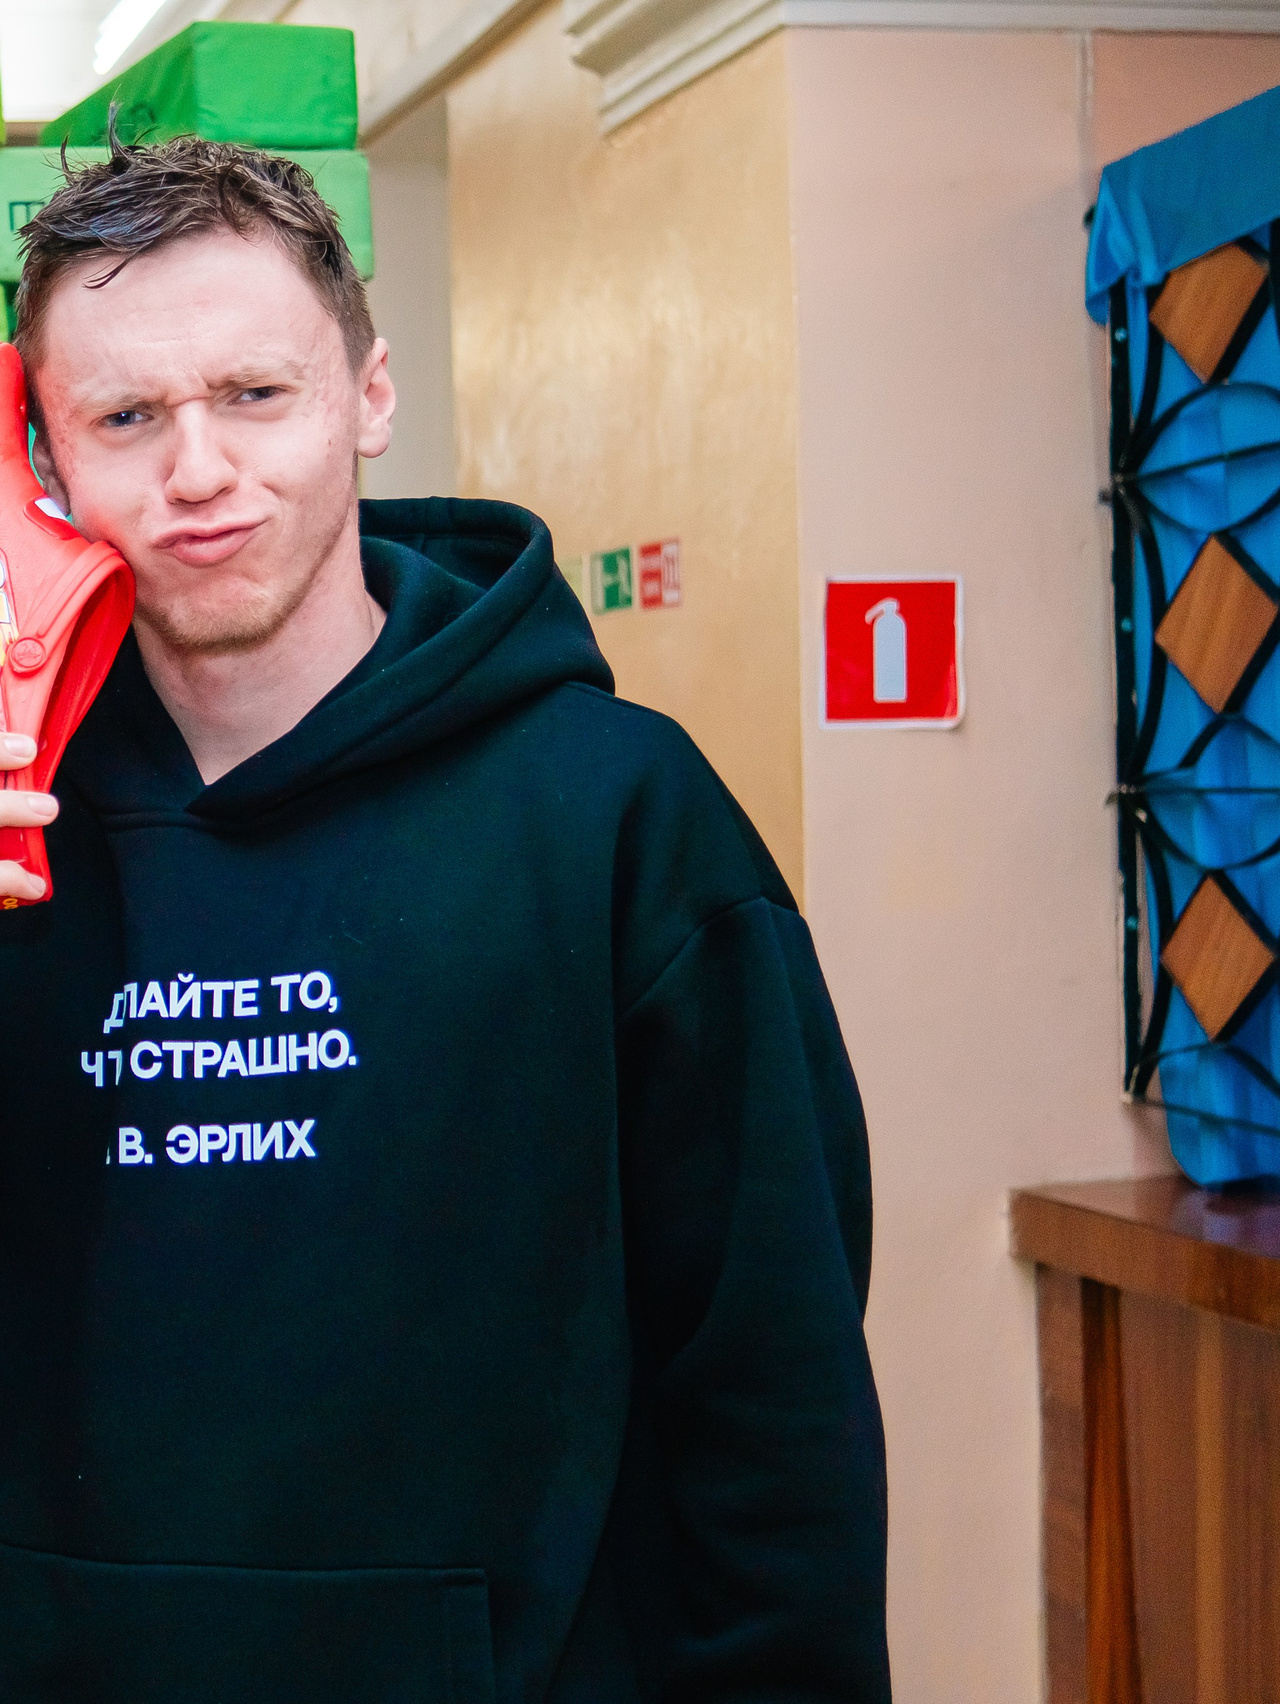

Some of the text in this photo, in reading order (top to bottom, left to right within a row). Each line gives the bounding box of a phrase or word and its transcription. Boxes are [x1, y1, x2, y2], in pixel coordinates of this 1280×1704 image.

[270, 971, 338, 1013] ТО,
[130, 1029, 357, 1079] СТРАШНО.
[118, 1127, 153, 1164] В.
[165, 1119, 316, 1164] ЭРЛИХ
